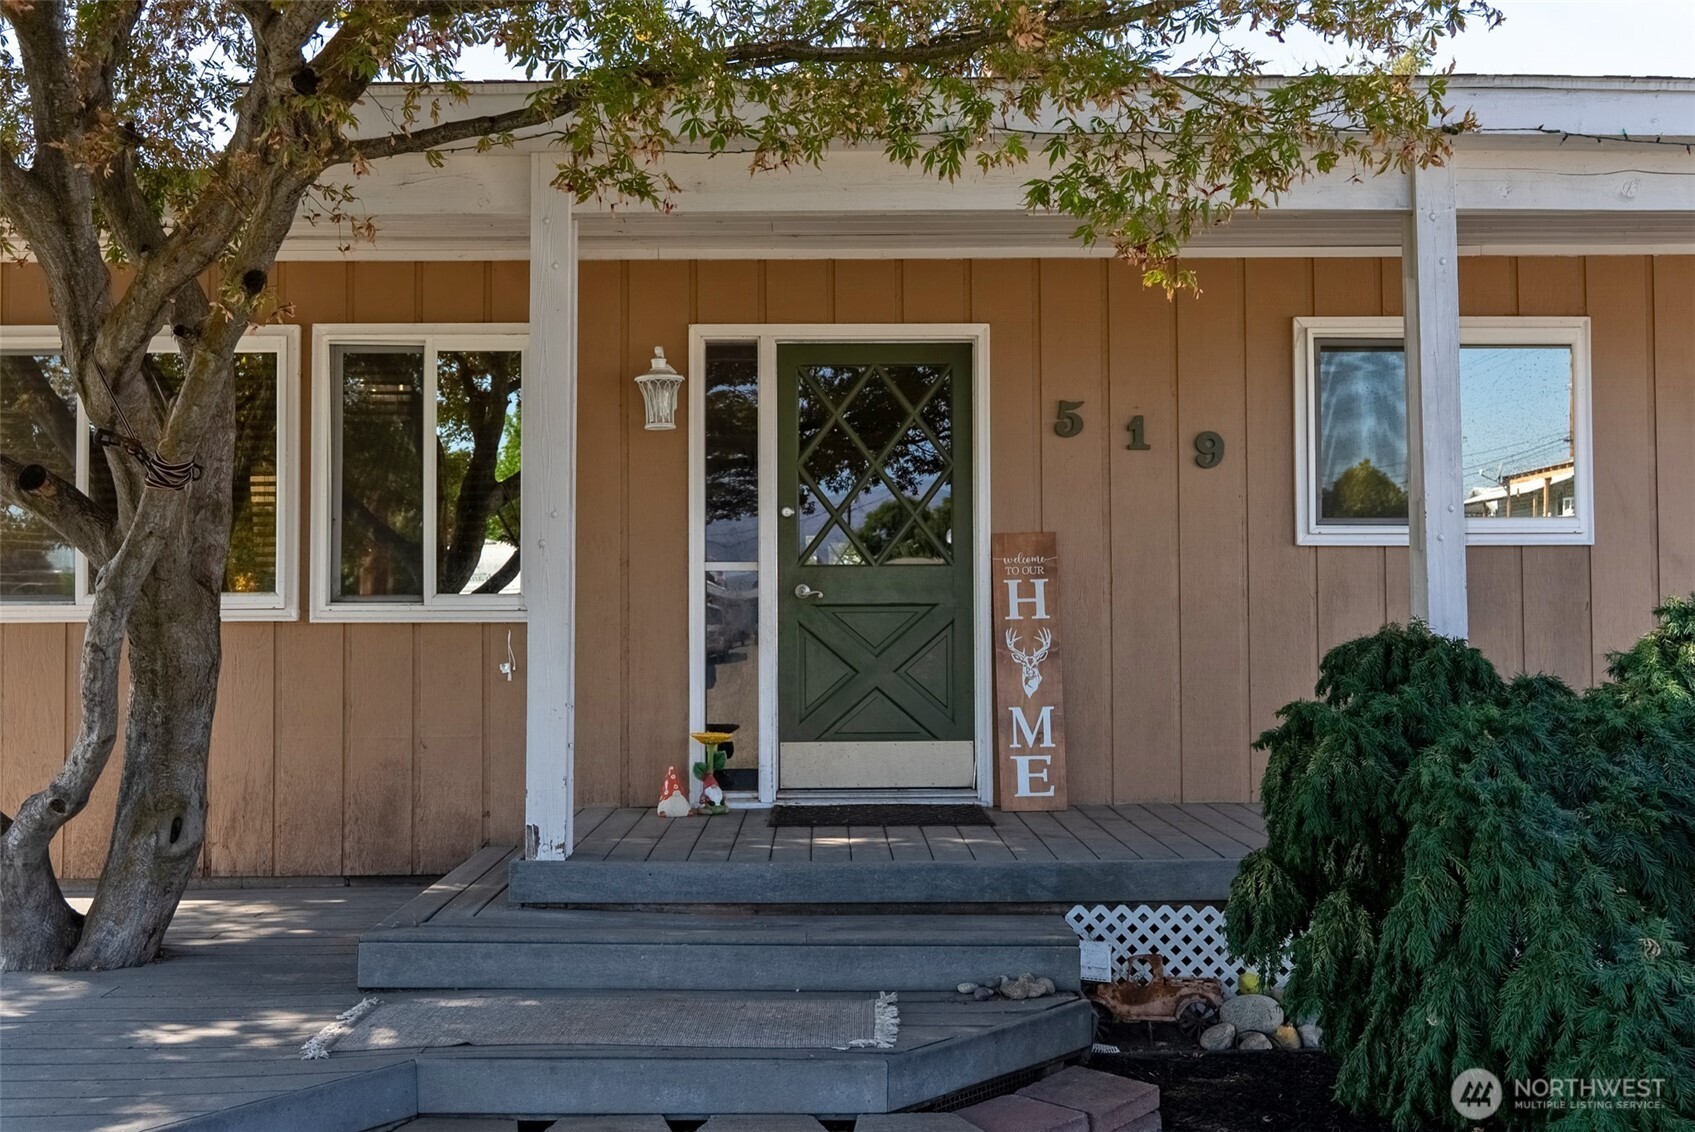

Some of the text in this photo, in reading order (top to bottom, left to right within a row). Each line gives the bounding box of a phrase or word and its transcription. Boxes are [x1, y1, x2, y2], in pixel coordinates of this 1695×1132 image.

[1003, 552, 1046, 565] welcome
[1004, 566, 1045, 576] TO OUR
